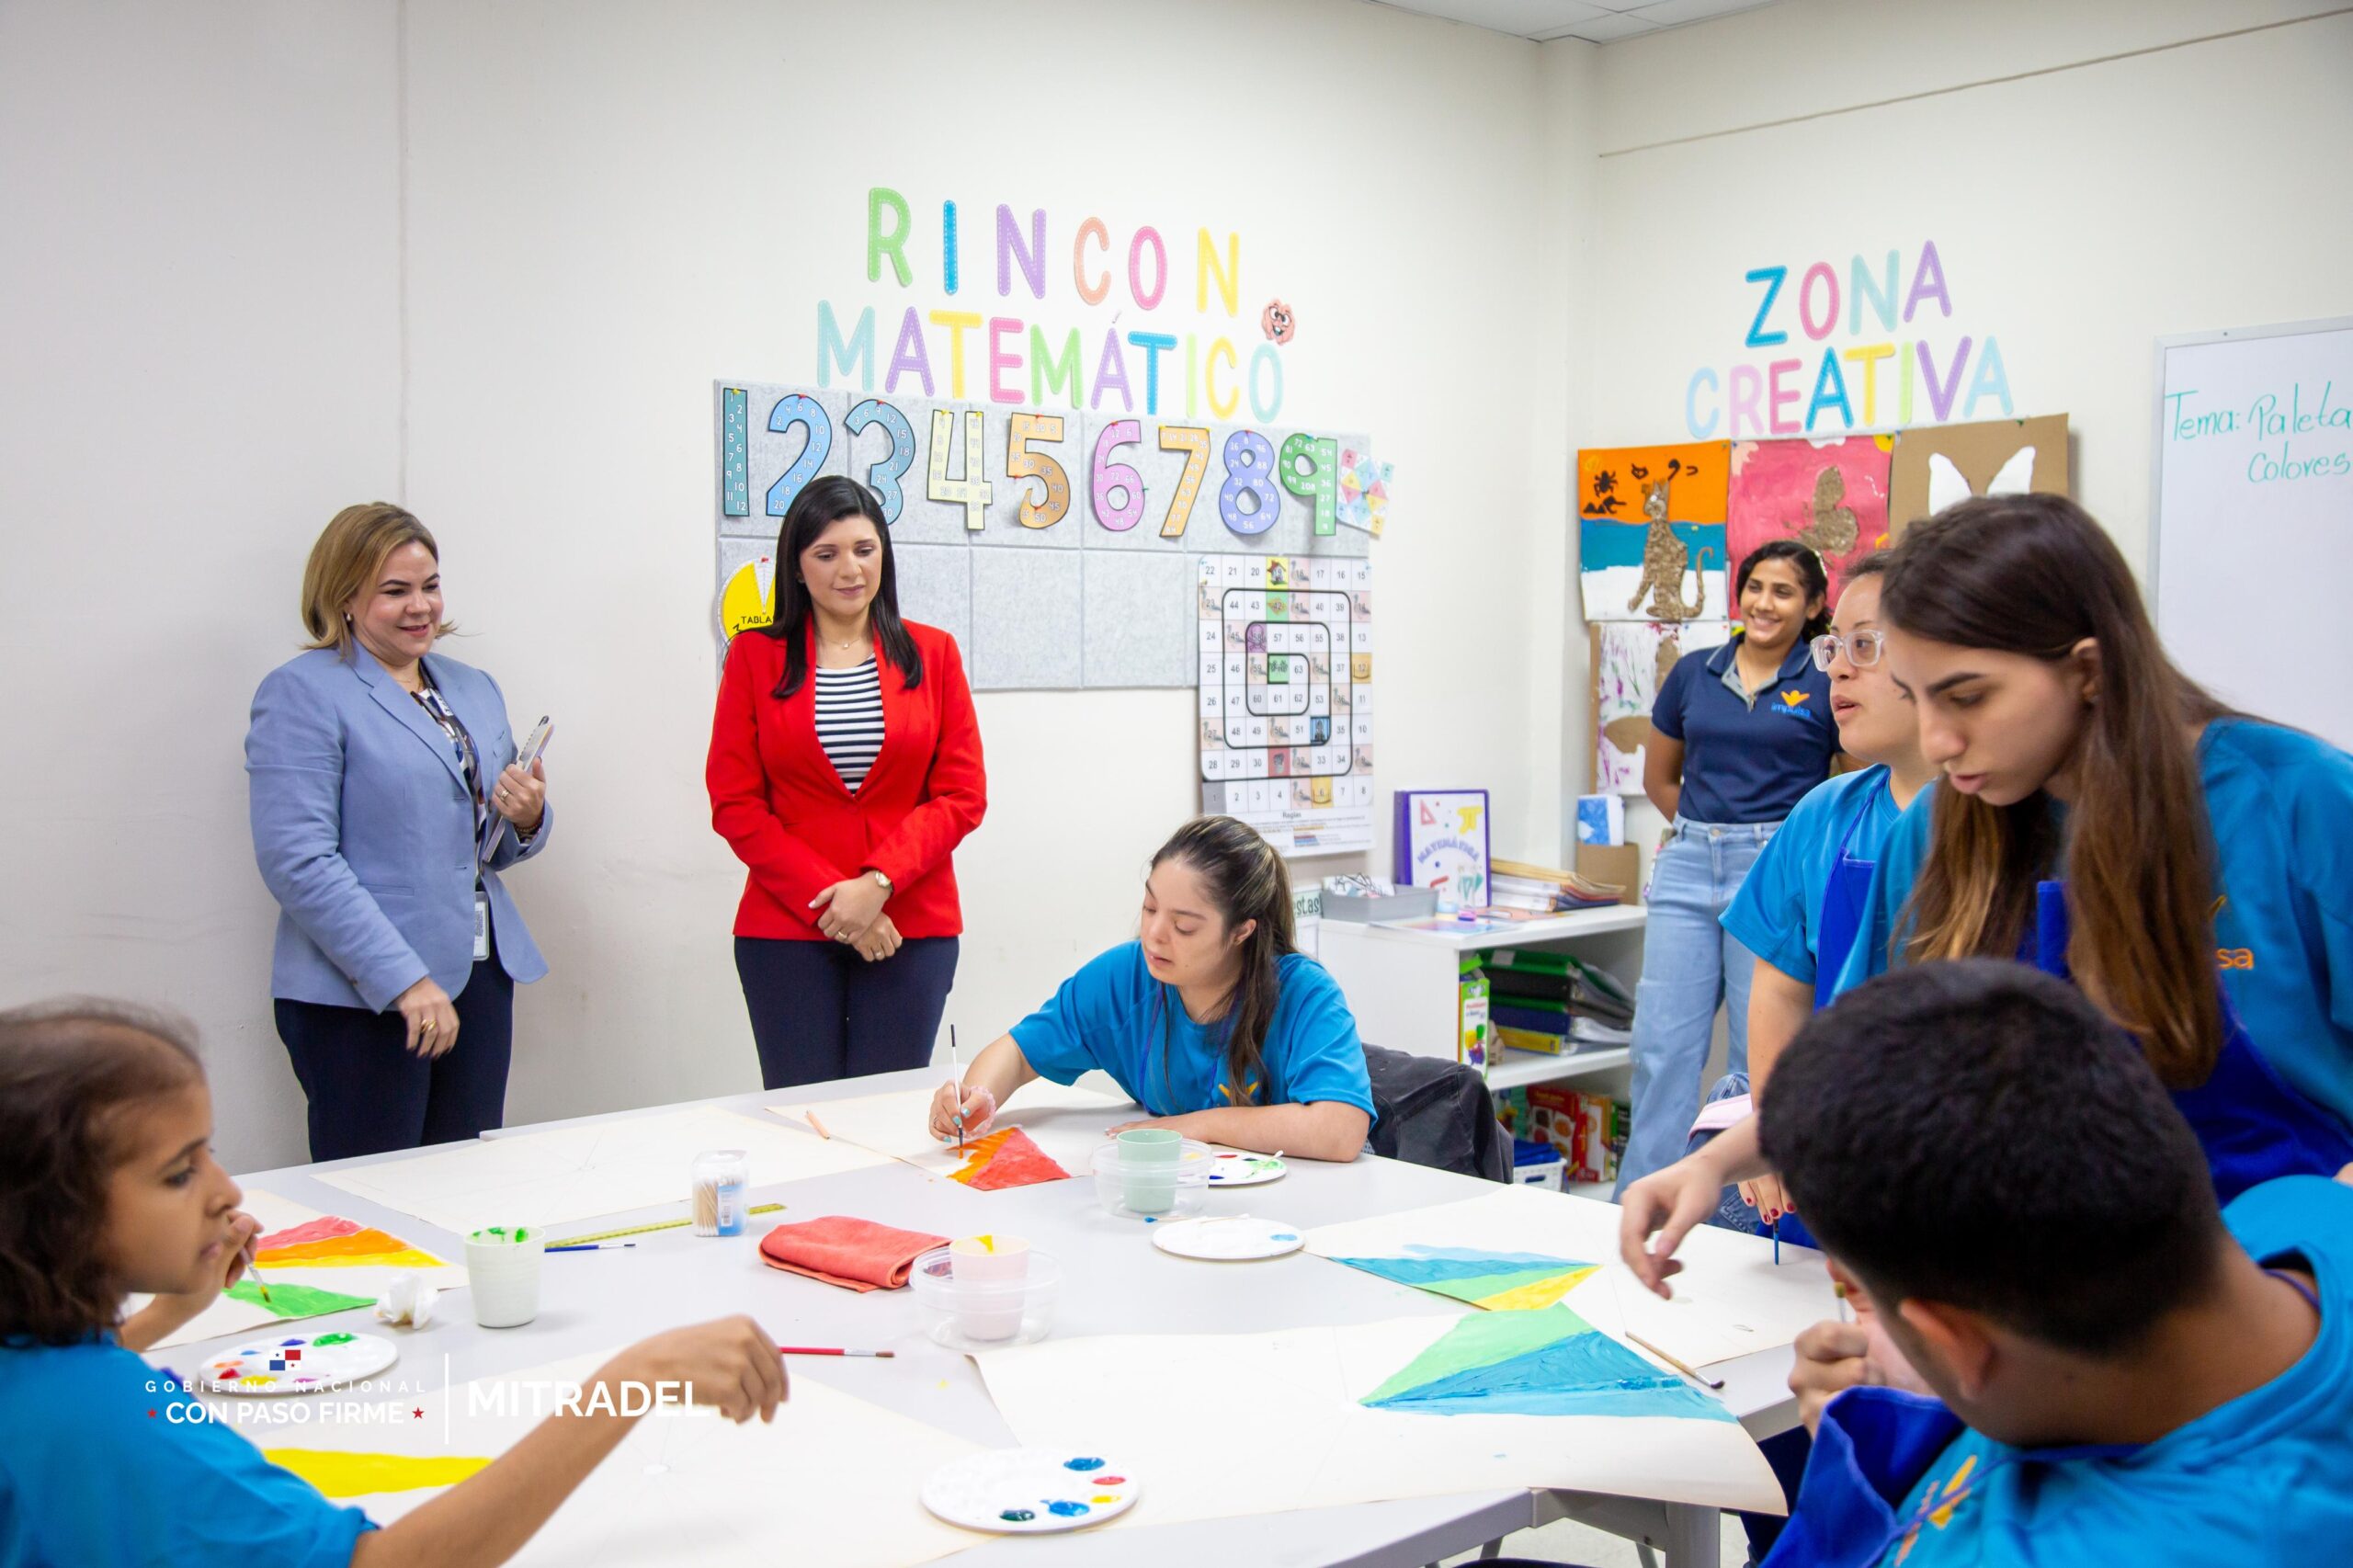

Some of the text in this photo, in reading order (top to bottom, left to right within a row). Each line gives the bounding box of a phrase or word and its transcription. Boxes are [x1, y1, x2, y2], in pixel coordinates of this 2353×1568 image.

[868, 187, 1239, 317] RINCON
[1745, 239, 1952, 347] ZONA
[817, 300, 1284, 424] MATEMÁTICO
[1686, 335, 2015, 439] CREATIVA
[730, 392, 733, 403] 1
[737, 404, 743, 415] 2
[786, 404, 790, 415] 4
[798, 403, 803, 412] 6
[811, 408, 816, 417] 8
[864, 408, 869, 417] 6
[876, 407, 881, 416] 9
[2164, 381, 2352, 441] Tema: Paleta
[729, 414, 734, 423] 3
[777, 416, 782, 426] 2
[855, 416, 860, 426] 3
[887, 414, 896, 424] 12
[736, 424, 743, 434] 4
[815, 425, 825, 435] 10
[897, 428, 907, 439] 15
[728, 433, 734, 442] 5
[736, 443, 743, 453] 6
[812, 443, 822, 451] 12
[900, 447, 910, 456] 18
[729, 453, 734, 461] 7
[2248, 441, 2351, 483] Colores
[723, 388, 1337, 537] 1 2 3 4 5 6 7 8 9
[736, 463, 742, 472] 8
[804, 460, 813, 469] 14
[889, 461, 899, 471] 21
[726, 470, 733, 480] 9
[793, 473, 802, 483] 16
[876, 474, 887, 484] 24
[735, 482, 745, 492] 10
[782, 485, 790, 495] 18
[727, 492, 733, 501] 11
[886, 490, 898, 500] 27
[736, 501, 746, 511] 12
[774, 500, 785, 509] 20
[883, 506, 893, 517] 30
[1206, 566, 1214, 575] 22
[1229, 567, 1237, 576] 21
[1251, 568, 1260, 577] 20
[1316, 570, 1324, 579] 17
[1337, 571, 1346, 580] 16
[1358, 571, 1366, 581] 15
[1230, 600, 1239, 610] 44
[1251, 600, 1260, 610] 43
[1315, 603, 1324, 612] 40
[1336, 603, 1345, 612] 39
[1207, 631, 1216, 641] 24
[1273, 633, 1282, 642] 57
[1295, 633, 1304, 643] 56
[1315, 633, 1324, 643] 55
[1336, 632, 1345, 642] 38
[1358, 633, 1366, 642] 13
[1207, 665, 1216, 674] 25
[1231, 664, 1240, 673] 46
[1294, 665, 1303, 675] 63
[1336, 663, 1345, 672] 37
[1207, 694, 1366, 707] 26 47 60 61 62 53 11
[1232, 727, 1241, 736] 48
[1252, 726, 1261, 736] 49
[1295, 724, 1304, 734] 51
[1336, 724, 1345, 734] 35
[1358, 724, 1367, 734] 10
[1209, 755, 1346, 770] 28 29 30 33 34
